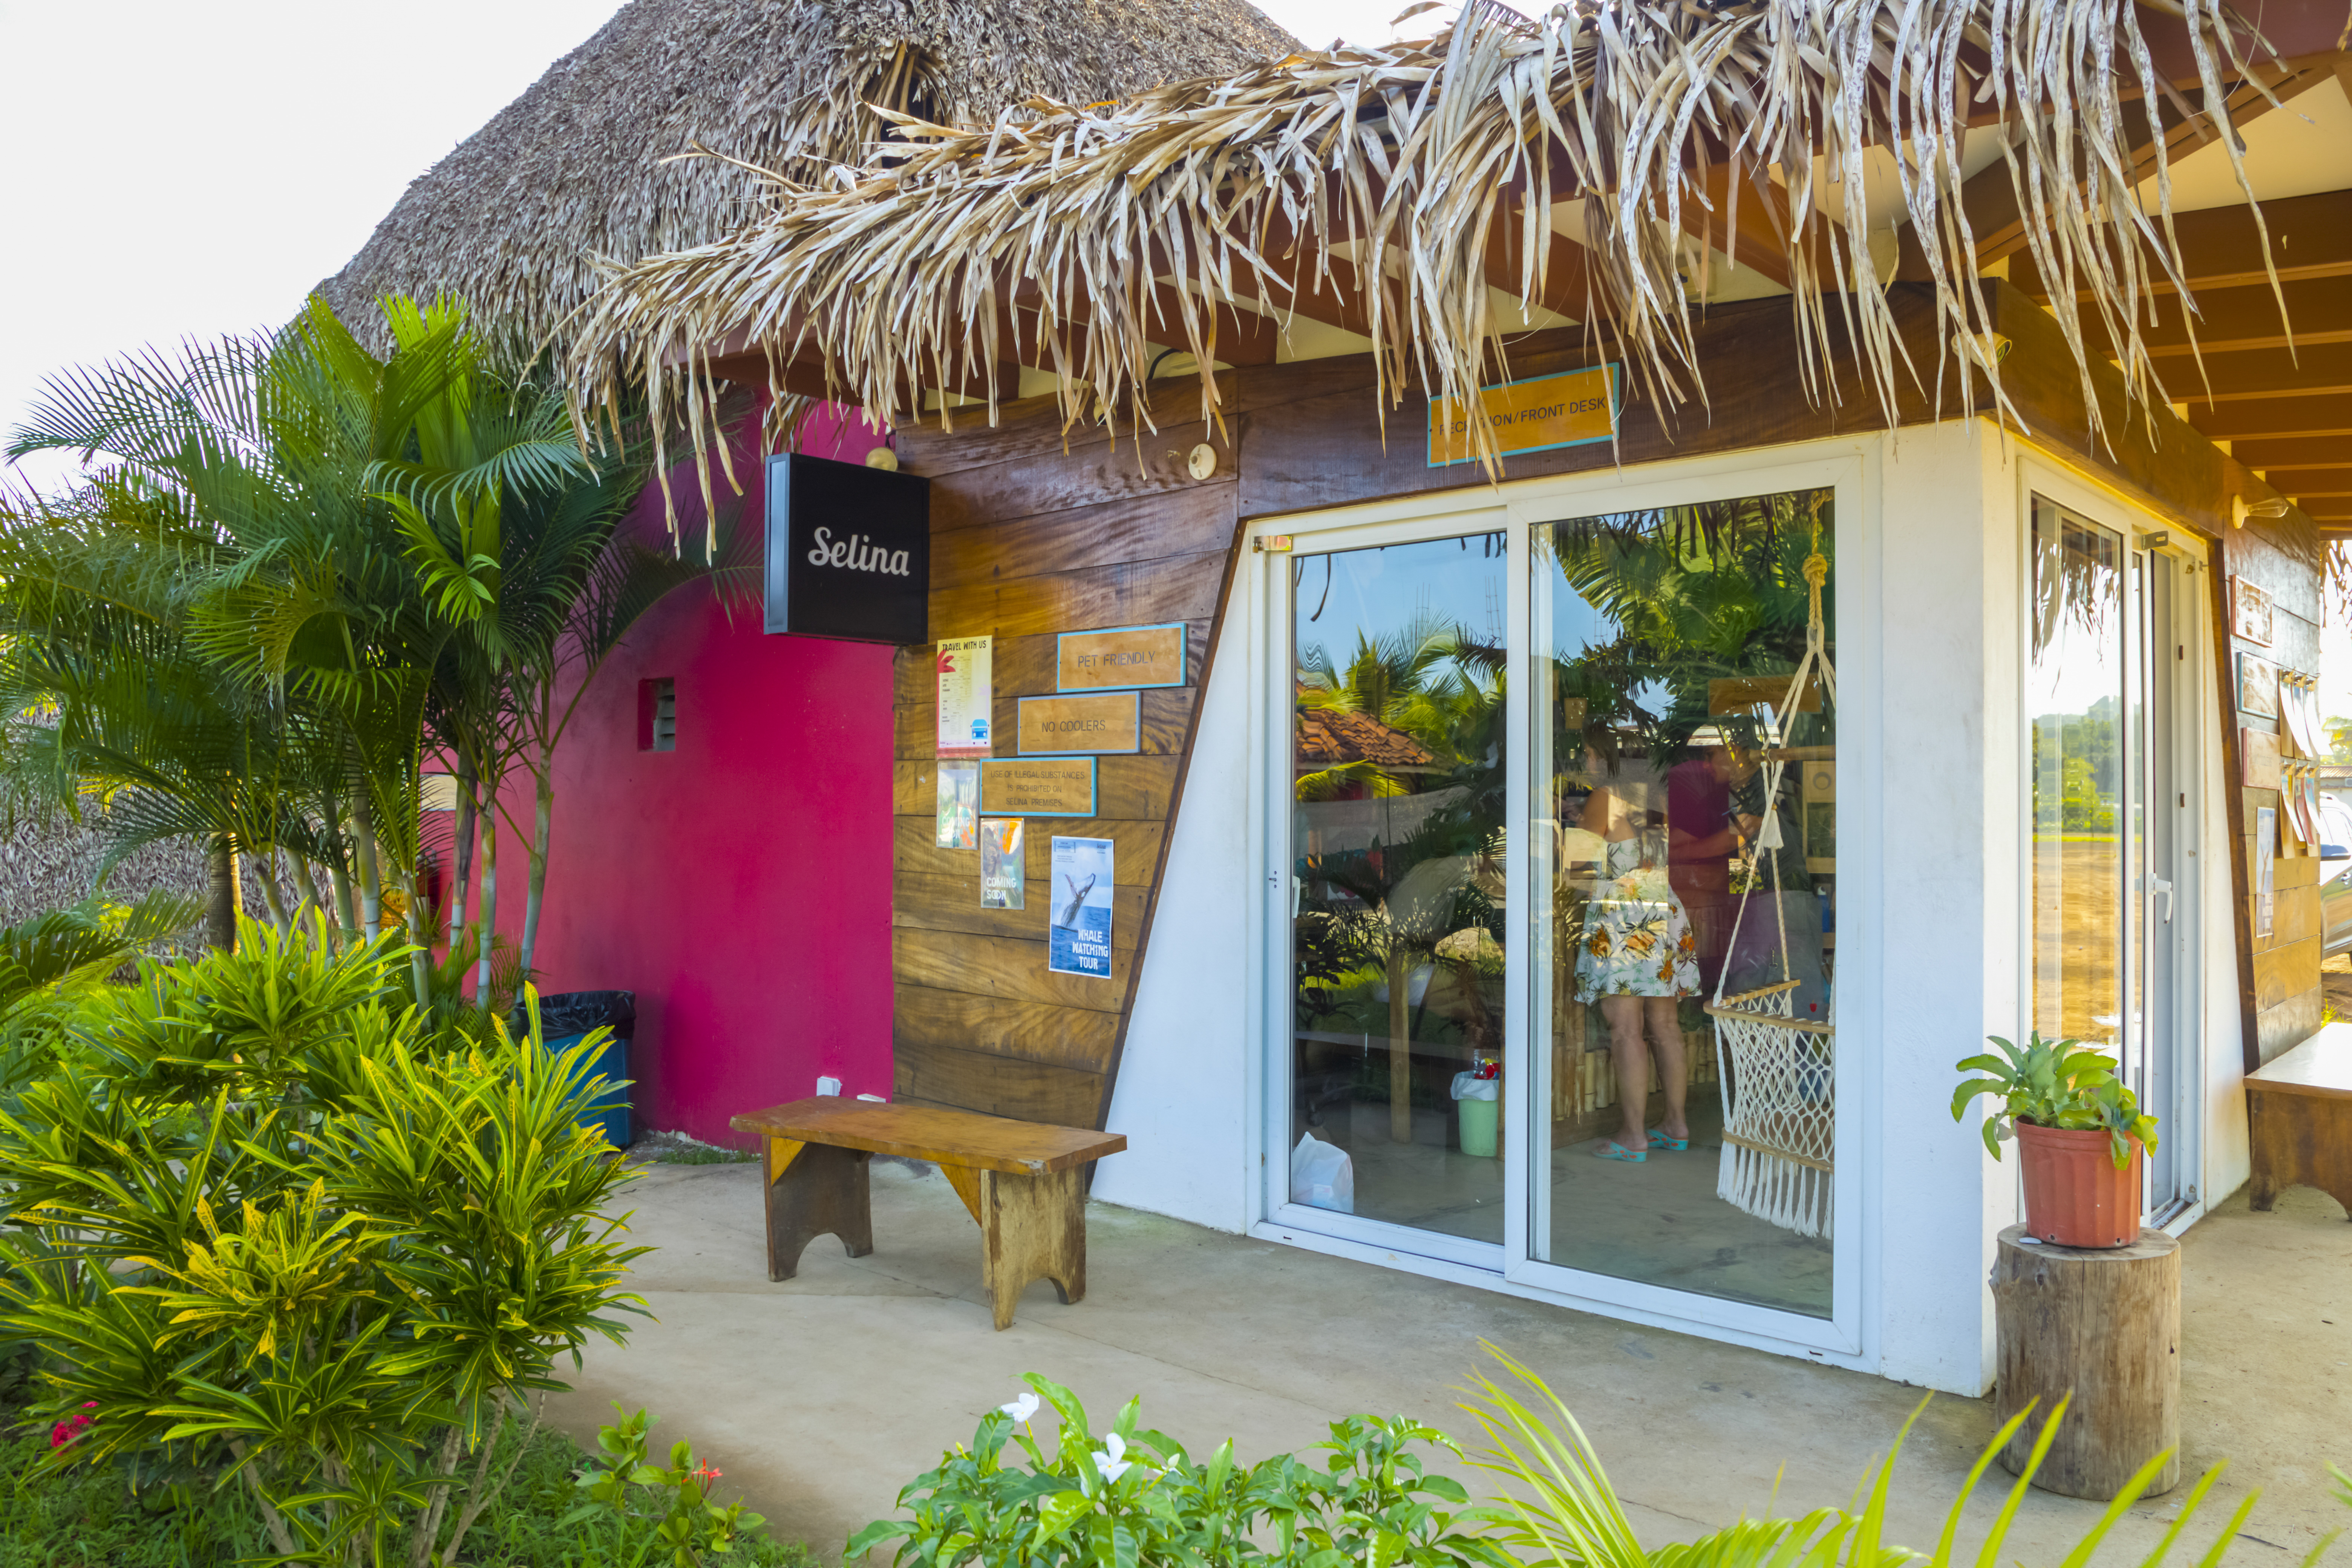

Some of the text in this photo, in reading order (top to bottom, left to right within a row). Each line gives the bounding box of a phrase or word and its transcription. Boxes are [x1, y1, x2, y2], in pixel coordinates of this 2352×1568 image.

[1570, 397, 1606, 414] DESK
[808, 526, 910, 576] Selina
[943, 643, 961, 651] TRAVEL
[964, 641, 977, 650] WITH
[1078, 651, 1155, 667] PET FRIENDLY
[1042, 720, 1106, 732] NO COOLERS
[1041, 771, 1085, 779] SUBSTANCES
[1031, 798, 1062, 807] PREMISES
[987, 877, 1017, 888] COMING
[987, 889, 1006, 900] SOON
[1078, 929, 1102, 943] WHALE
[1072, 942, 1108, 957] WATCHING
[1079, 956, 1098, 970] TOUR
